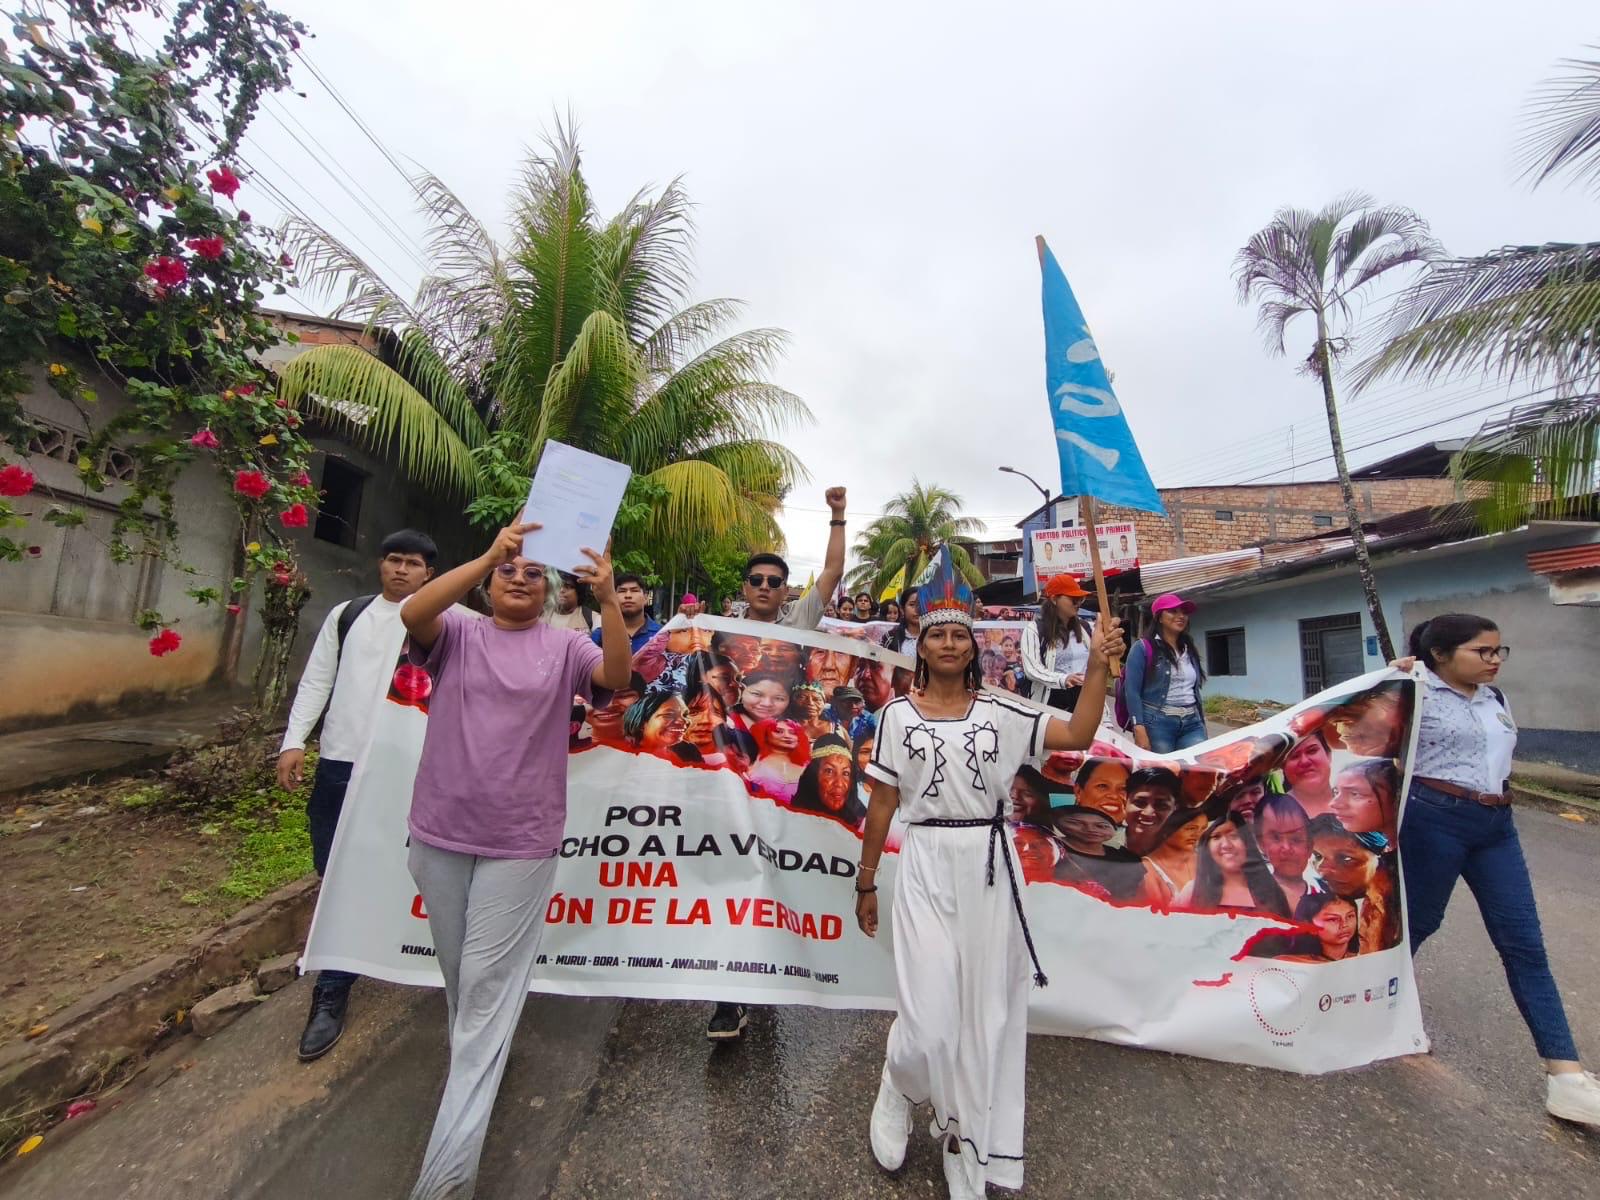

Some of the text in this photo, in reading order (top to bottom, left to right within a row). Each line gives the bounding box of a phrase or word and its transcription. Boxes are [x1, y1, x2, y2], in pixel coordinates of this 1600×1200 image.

[1035, 531, 1060, 540] PARTIDO
[604, 805, 682, 827] POR
[638, 834, 666, 857] A
[675, 834, 723, 857] LA
[729, 833, 856, 878] VERDAD
[599, 862, 679, 889] UNA
[607, 898, 656, 926] DE
[666, 898, 713, 927] LA
[726, 898, 843, 941] VERDAD
[555, 954, 588, 966] MURUI
[592, 955, 619, 967] BORA
[627, 956, 664, 968] TIKUNA
[670, 958, 718, 972] AWAJUN
[726, 961, 777, 975] ARABELA
